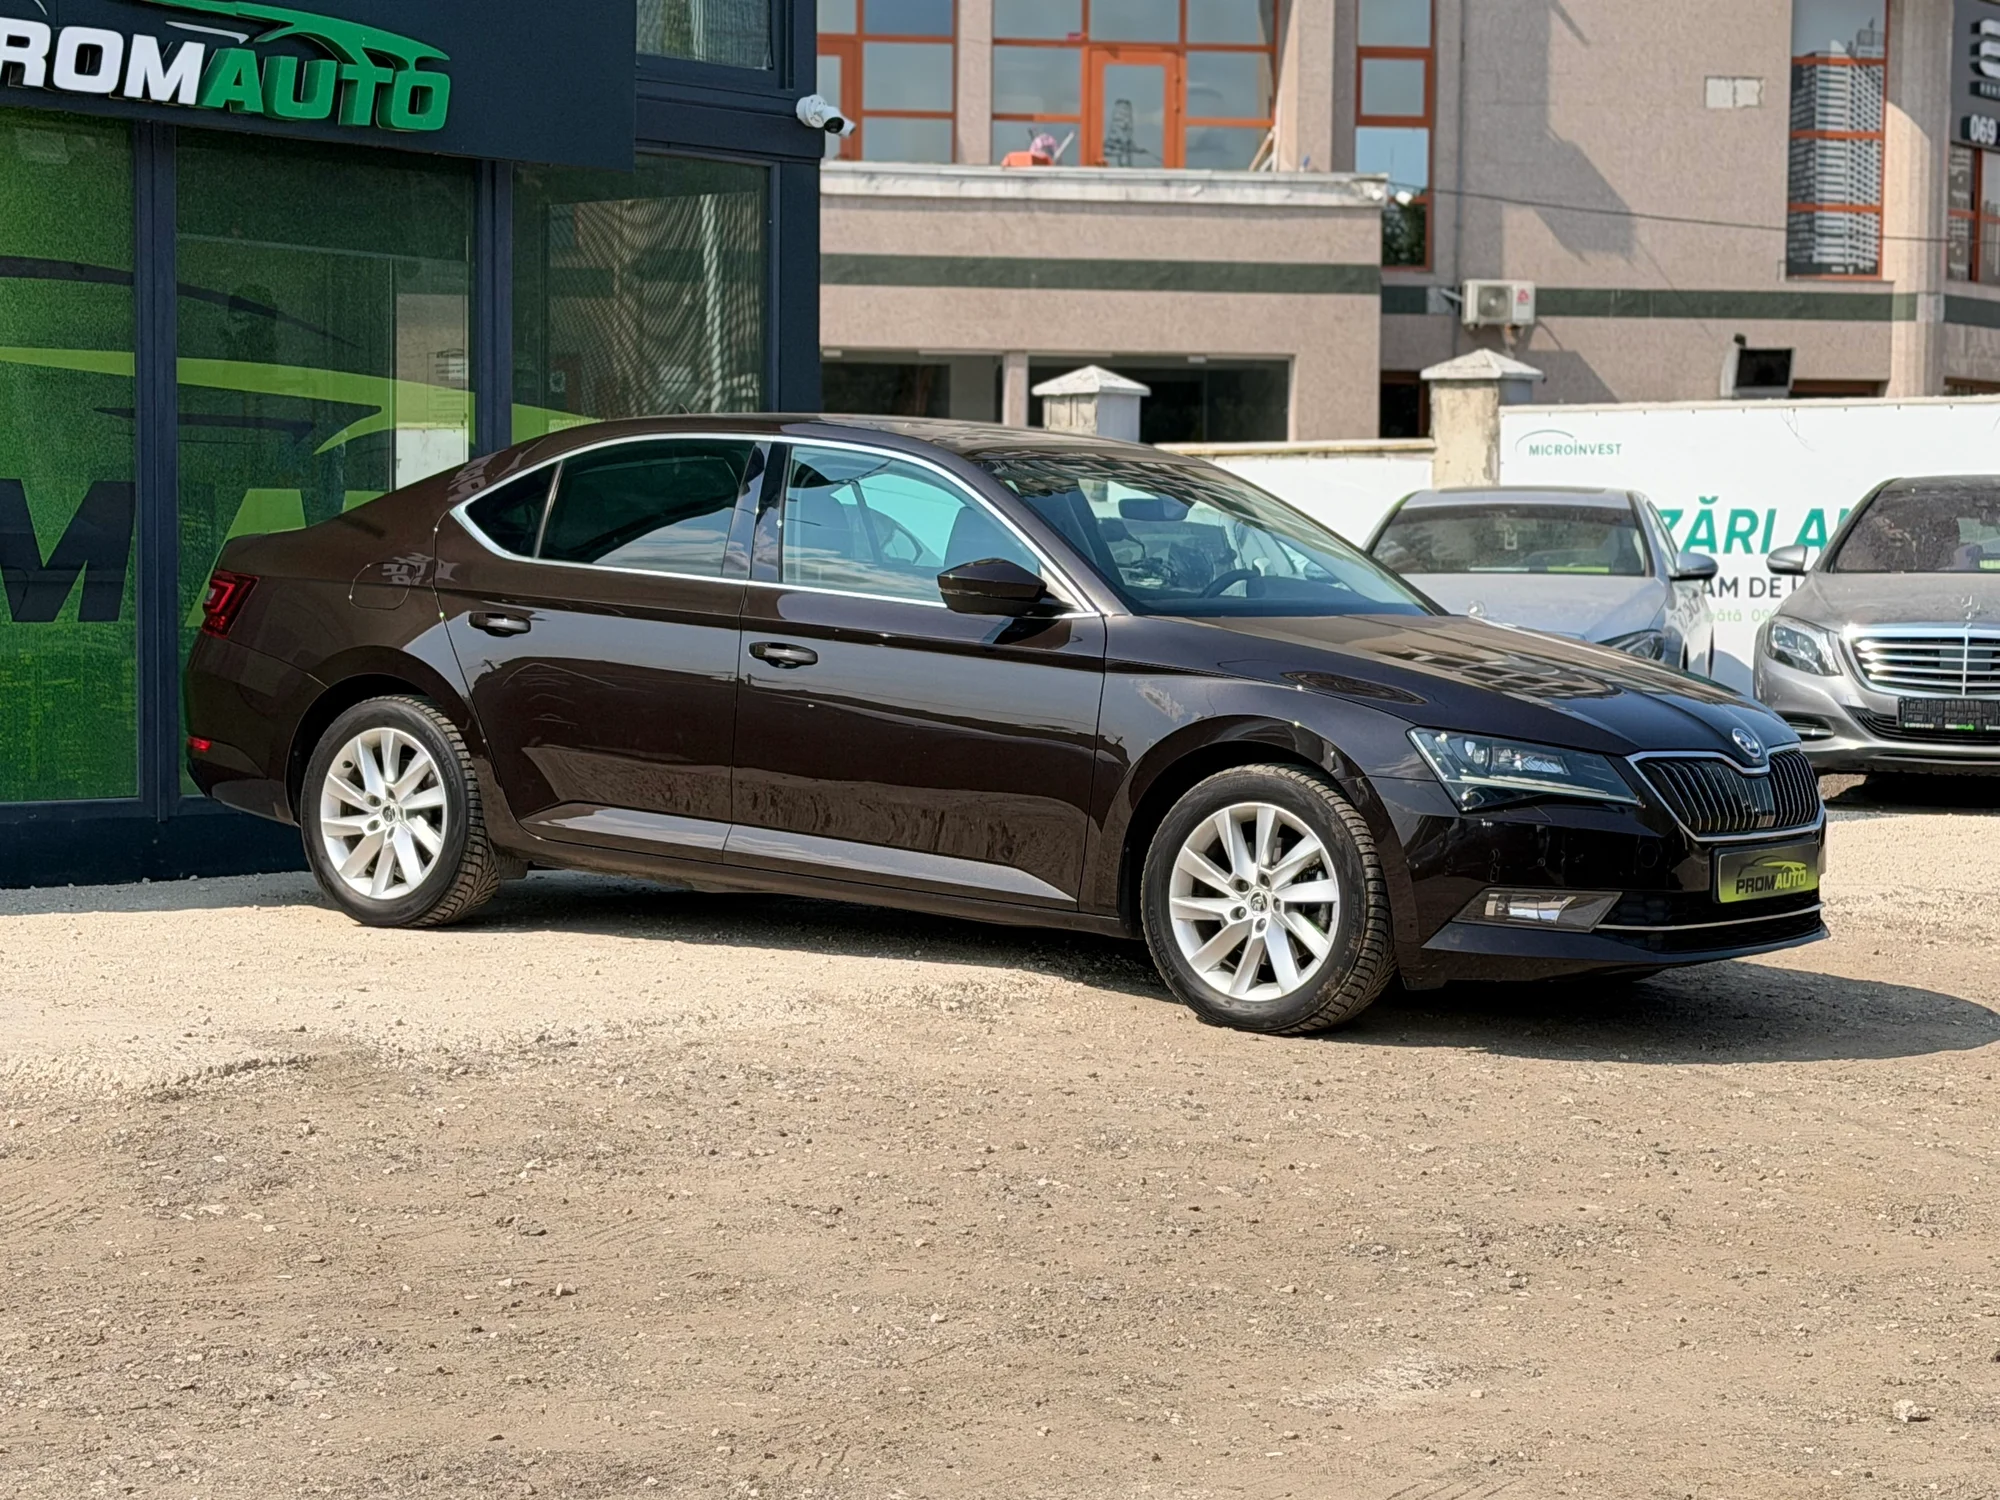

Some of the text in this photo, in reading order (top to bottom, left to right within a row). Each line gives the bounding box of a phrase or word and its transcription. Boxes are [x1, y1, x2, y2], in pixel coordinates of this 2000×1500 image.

[1528, 439, 1622, 456] MICROINVEST
[1749, 576, 1782, 599] DE
[1735, 868, 1807, 895] PROMAUTO
